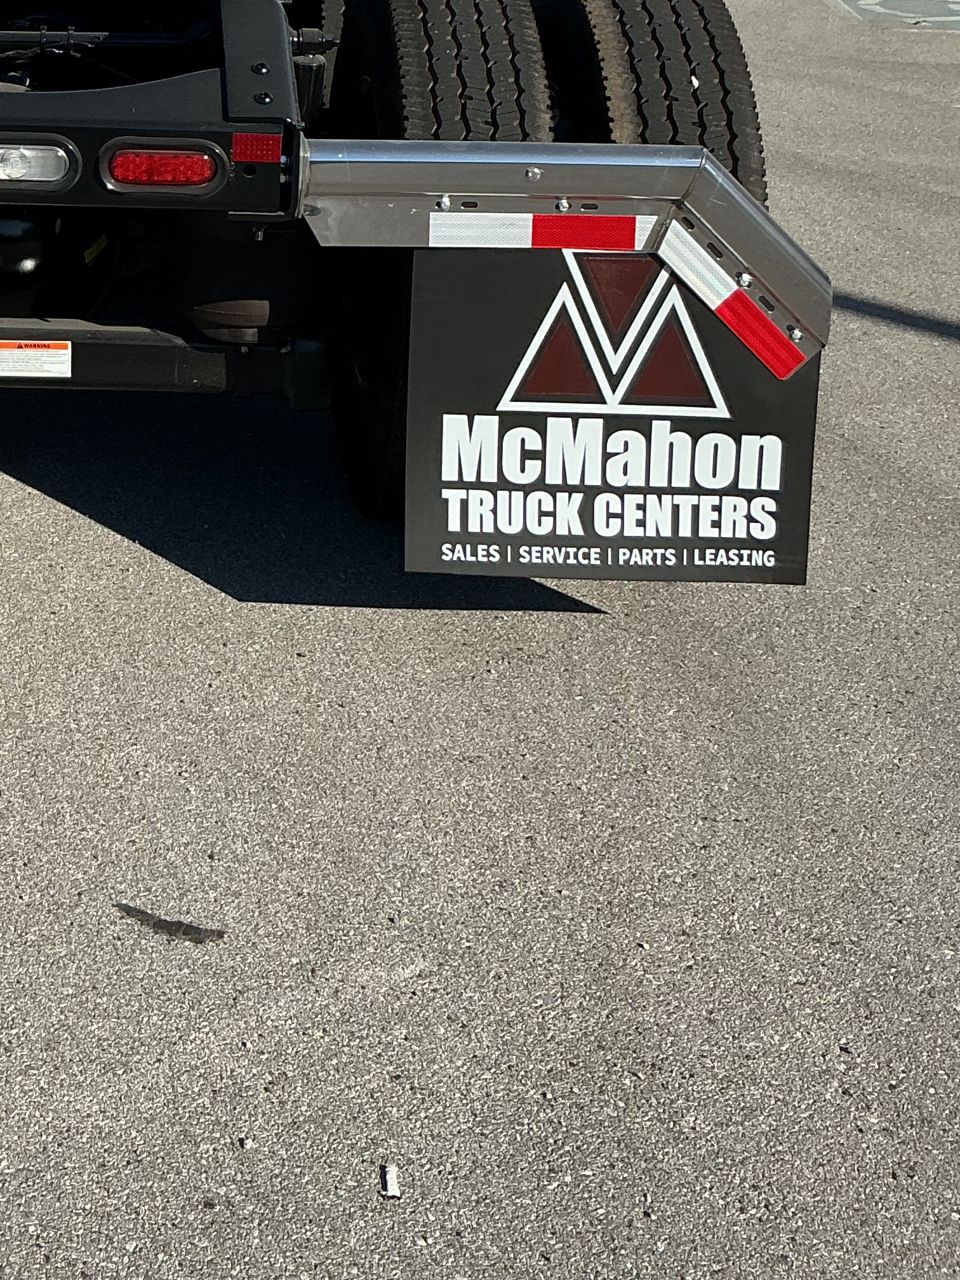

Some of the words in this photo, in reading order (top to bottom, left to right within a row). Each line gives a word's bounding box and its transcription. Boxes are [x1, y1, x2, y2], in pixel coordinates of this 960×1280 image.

[441, 413, 783, 490] McMahon
[441, 488, 585, 535] TRUCK
[593, 492, 777, 540] CENTERS
[441, 543, 501, 563] SALES
[518, 545, 601, 566] SERVICE
[618, 547, 677, 567] PARTS
[693, 548, 776, 568] LEASING
